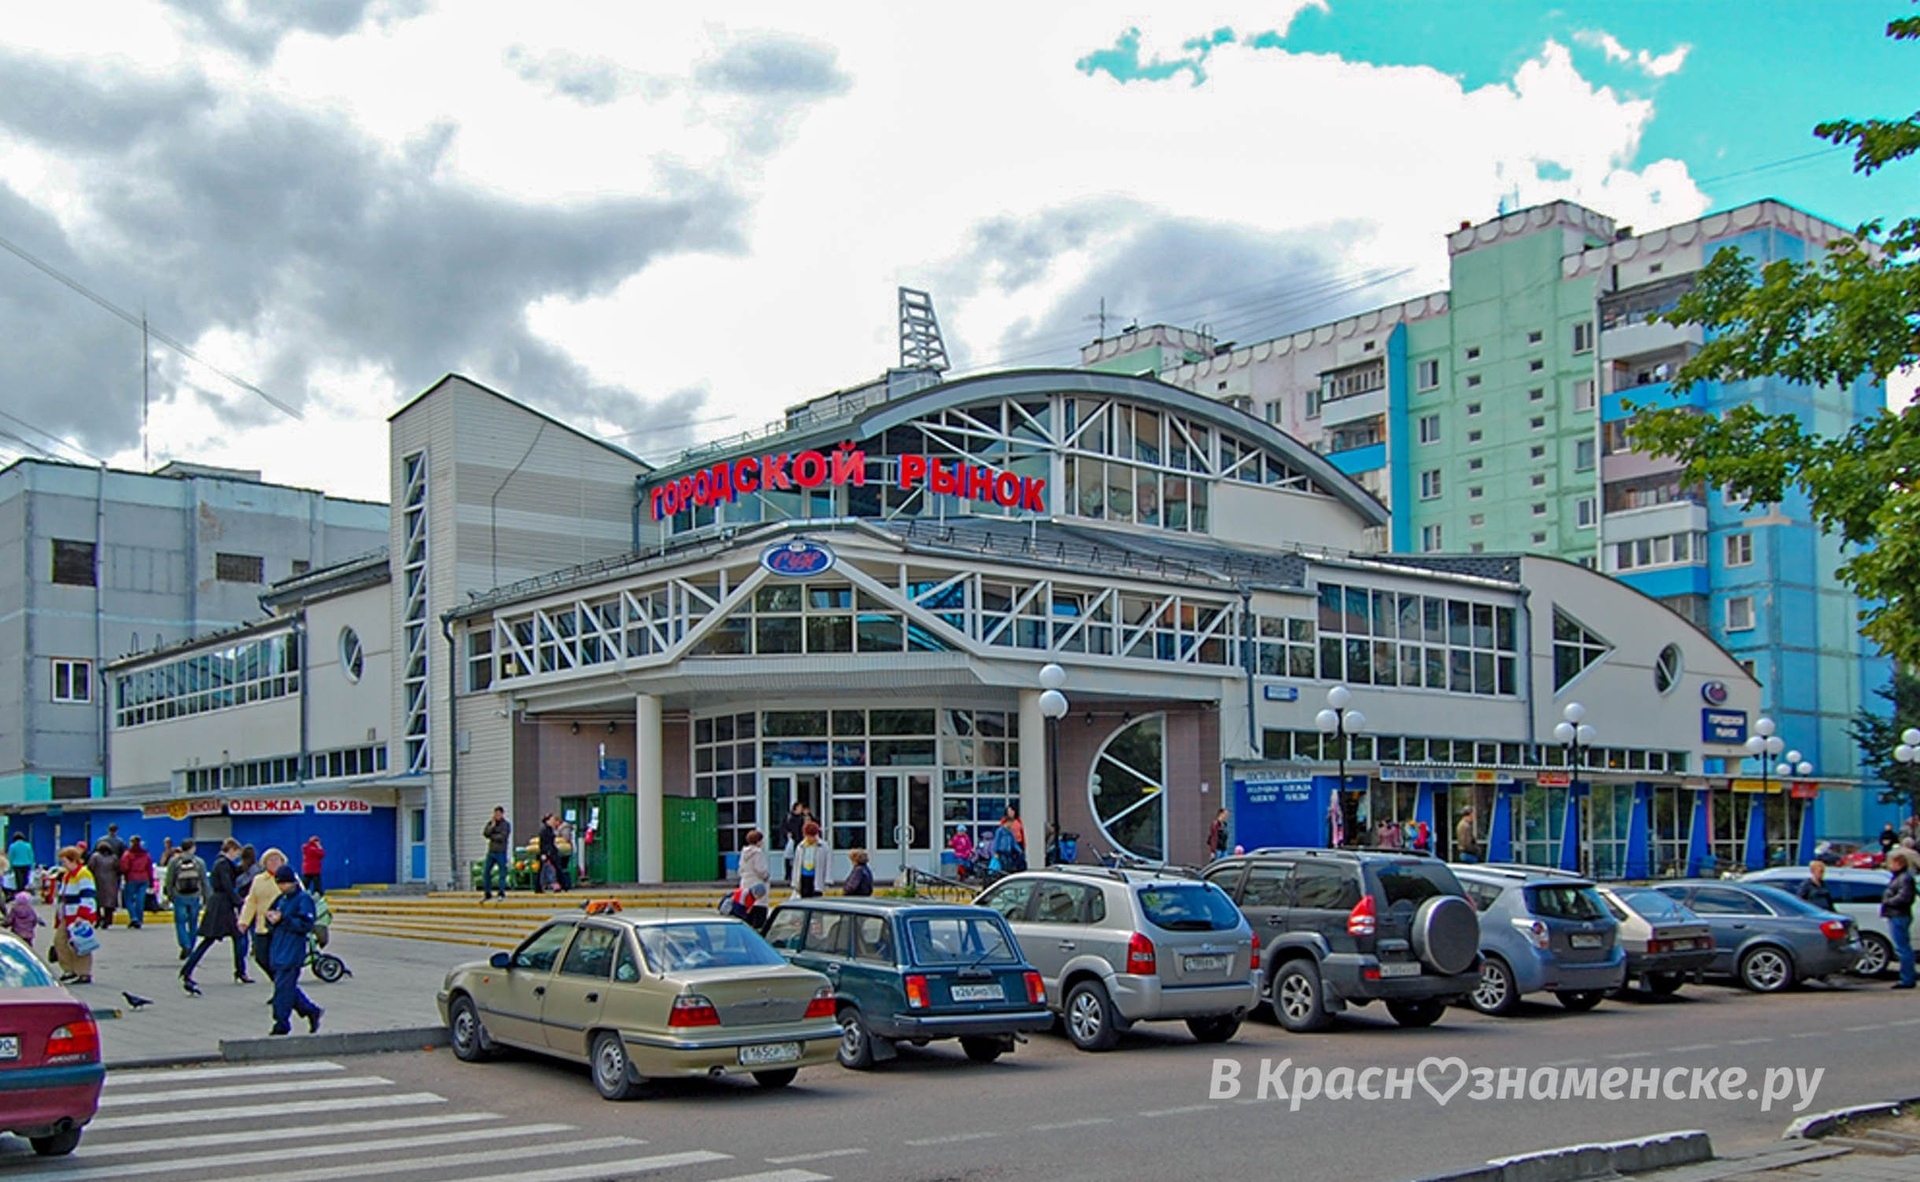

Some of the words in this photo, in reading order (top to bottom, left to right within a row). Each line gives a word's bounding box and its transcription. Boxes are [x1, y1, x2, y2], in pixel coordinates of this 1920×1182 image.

[651, 441, 866, 521] ГОРОДСКОЙ
[898, 454, 1045, 513] РЫНОК
[229, 799, 304, 812] ОДЕЖДА
[316, 799, 370, 812] ОБУВЬ
